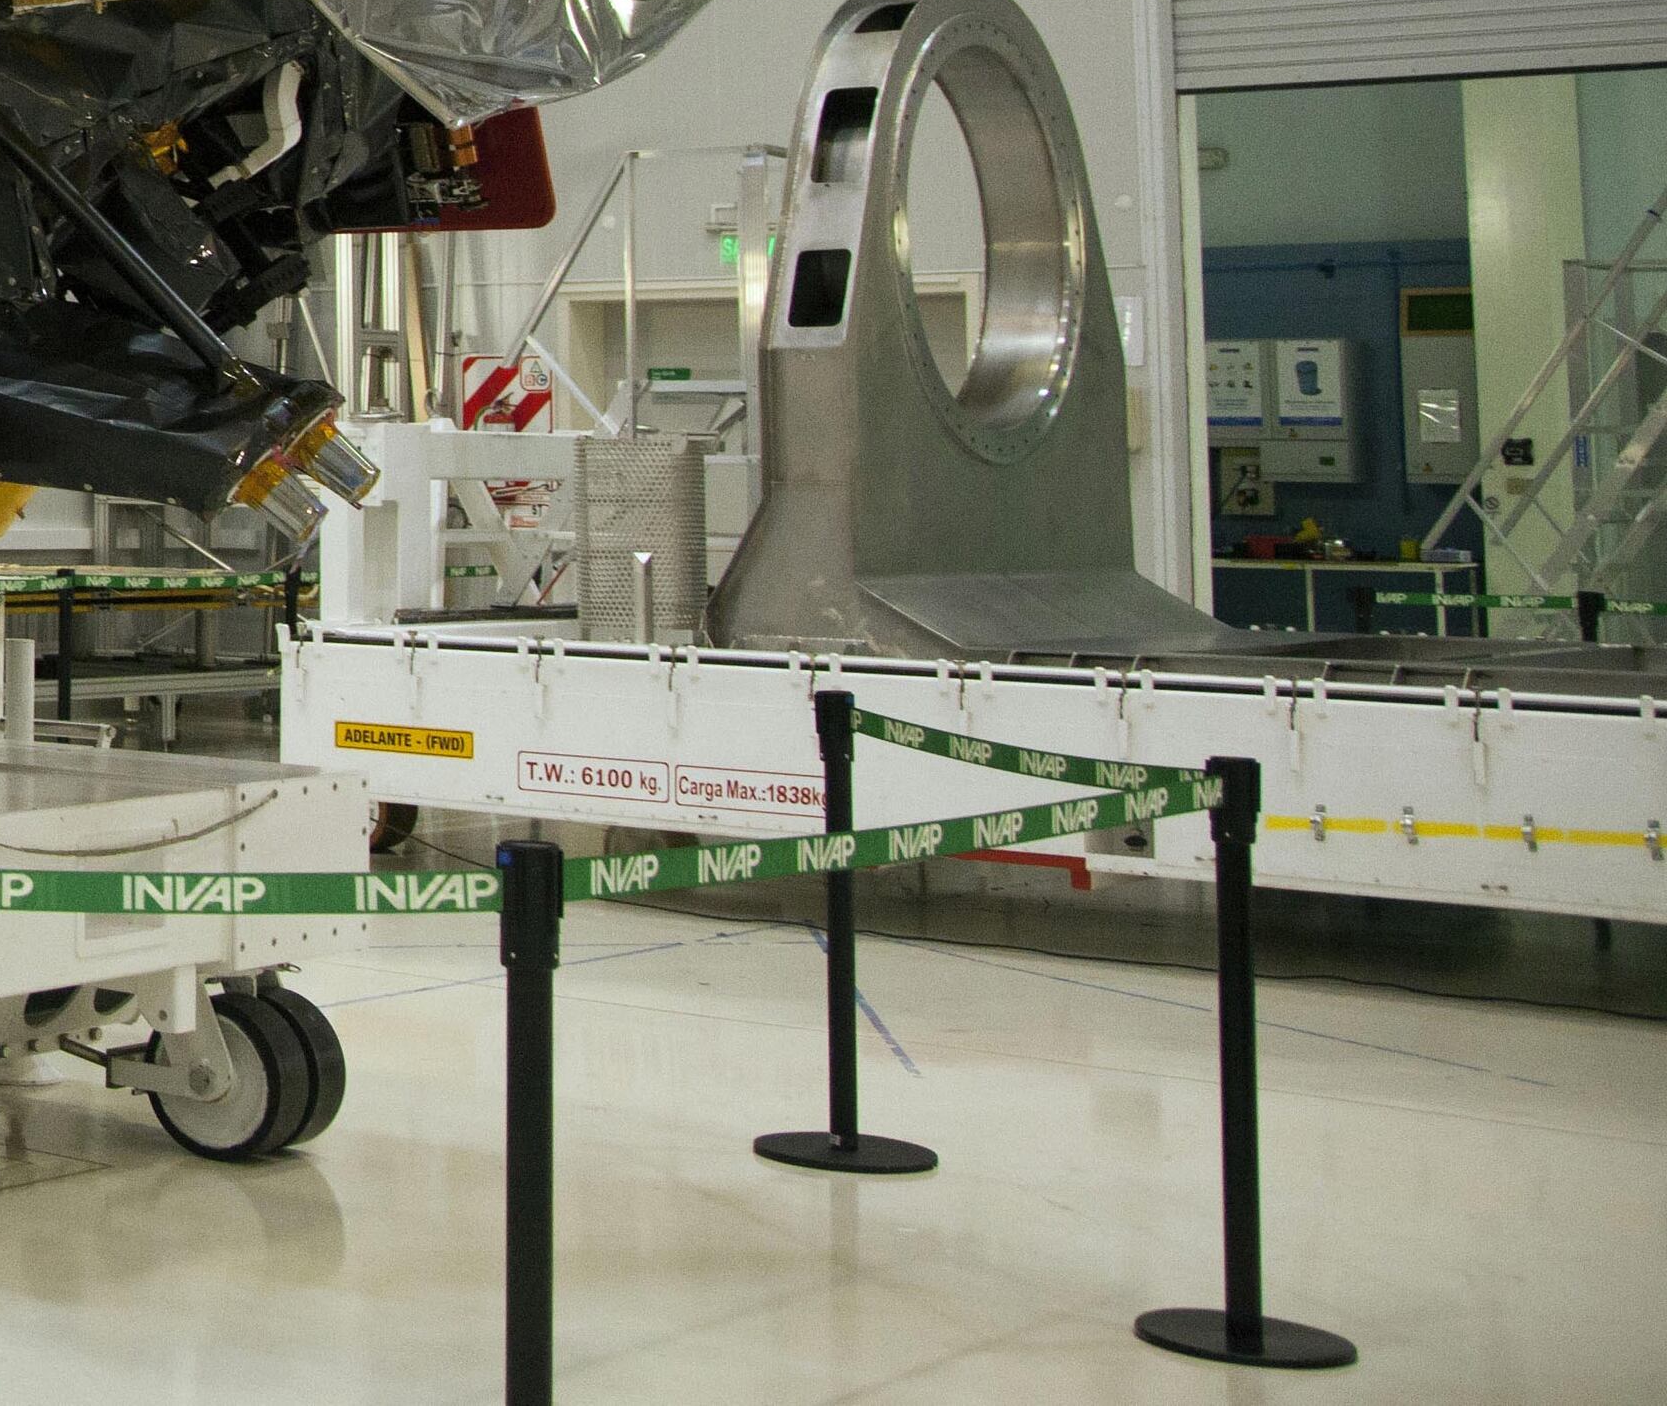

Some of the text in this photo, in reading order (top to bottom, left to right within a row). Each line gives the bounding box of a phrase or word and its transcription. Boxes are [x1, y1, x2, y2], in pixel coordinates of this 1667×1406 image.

[344, 727, 412, 749] ADELANTE
[426, 734, 466, 754] (FWD)
[526, 761, 662, 796] T.W.: 6100 kg.
[1019, 749, 1068, 779] INVAP
[1095, 760, 1148, 791] INVAP
[678, 776, 723, 801] Carga
[123, 874, 266, 912] INVAP
[355, 873, 500, 912] INVAP
[589, 854, 659, 895] INVAP
[697, 844, 761, 884] INVAP
[797, 834, 855, 873] INVAP
[888, 822, 943, 861] INVAP
[973, 812, 1024, 849] INVAP
[1051, 798, 1098, 834] INVAP
[1124, 787, 1168, 821] INVAP
